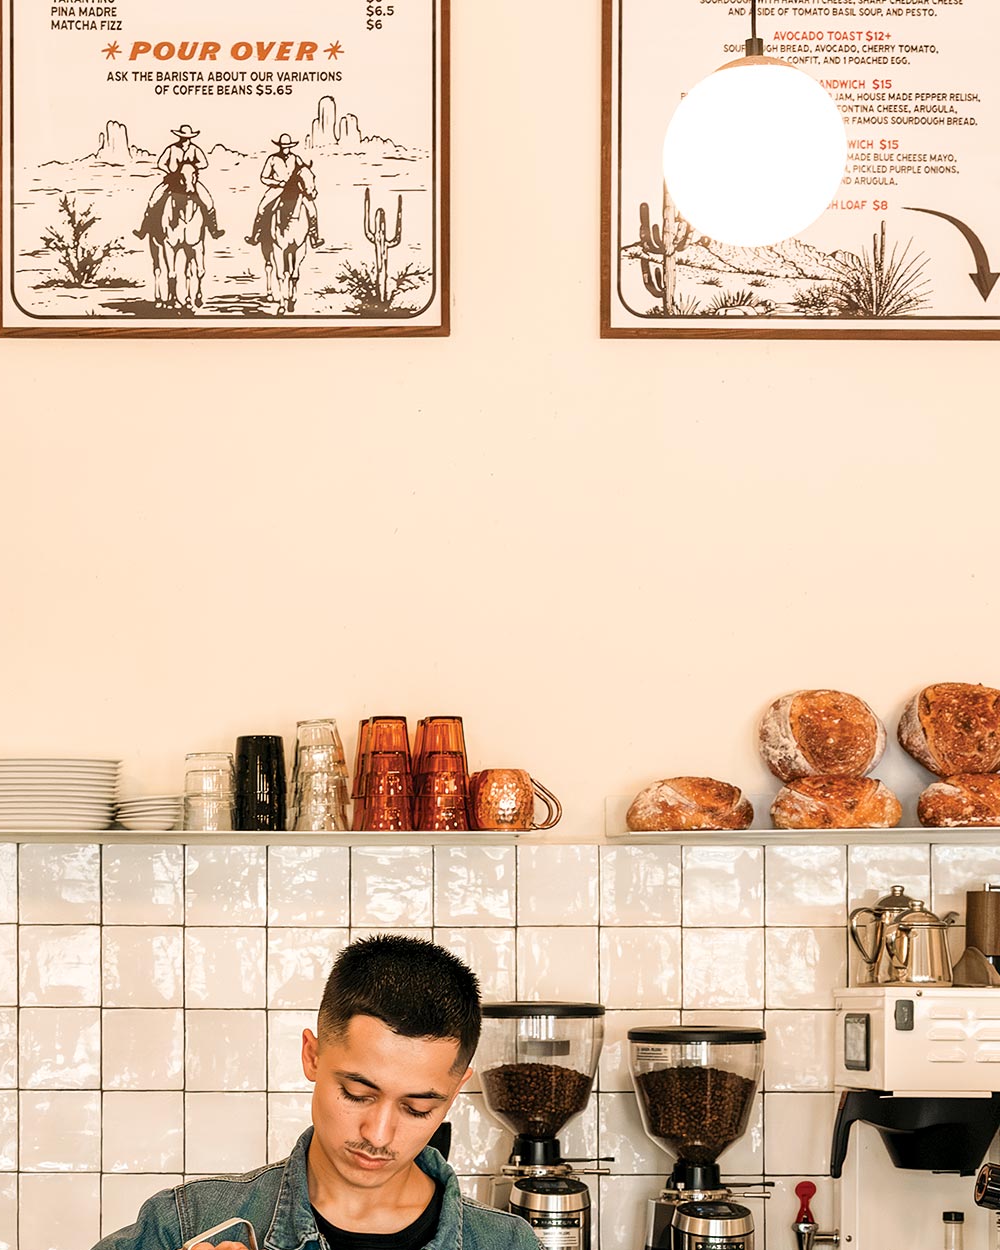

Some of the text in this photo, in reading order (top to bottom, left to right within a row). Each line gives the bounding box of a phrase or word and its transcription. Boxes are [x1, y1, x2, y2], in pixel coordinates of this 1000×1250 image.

[51, 7, 118, 17] PINA MADRE
[366, 5, 395, 17] $6.5
[728, 8, 746, 16] AND
[757, 8, 775, 16] SIDE
[777, 8, 789, 16] OF
[791, 8, 831, 16] TOMATO
[832, 8, 857, 16] BASIL
[859, 8, 884, 17] SOUP,
[886, 8, 904, 16] AND
[906, 8, 938, 17] PESTO.
[51, 20, 123, 31] MATCHA FIZZ
[366, 19, 383, 31] $6
[773, 30, 892, 42] AVOCADO TOAST $12+
[128, 41, 319, 61] POUR OVER
[780, 45, 813, 54] BREAD,
[814, 44, 860, 54] AVOCADO,
[862, 45, 896, 53] CHERRY
[898, 45, 940, 55] TOMATO,
[787, 56, 821, 65] CONFIT,
[823, 56, 842, 64] AND
[848, 57, 889, 65] POACHED
[891, 57, 911, 65] EGG.
[107, 71, 343, 82] ASK THE BARISTA ABOUT OUR VARIATIONS
[155, 84, 293, 96] OF COFFEE BEANS $5.65
[872, 79, 893, 90] $15
[857, 93, 887, 101] HOUSE
[888, 93, 913, 101] MADE
[915, 93, 948, 102] PEPPER
[949, 93, 981, 103] RELISH,
[877, 105, 912, 114] CHEESE,
[852, 116, 889, 125] FAMOUS
[891, 116, 945, 125] SOURDOUGH
[880, 139, 900, 151] $15
[873, 153, 895, 162] BLUE
[896, 154, 928, 162] CHEESE
[853, 165, 888, 174] PICKLED
[889, 165, 922, 174] PURPLE
[855, 177, 899, 186] ARUGULA.
[841, 200, 868, 210] LOAF
[873, 200, 888, 211] $8
